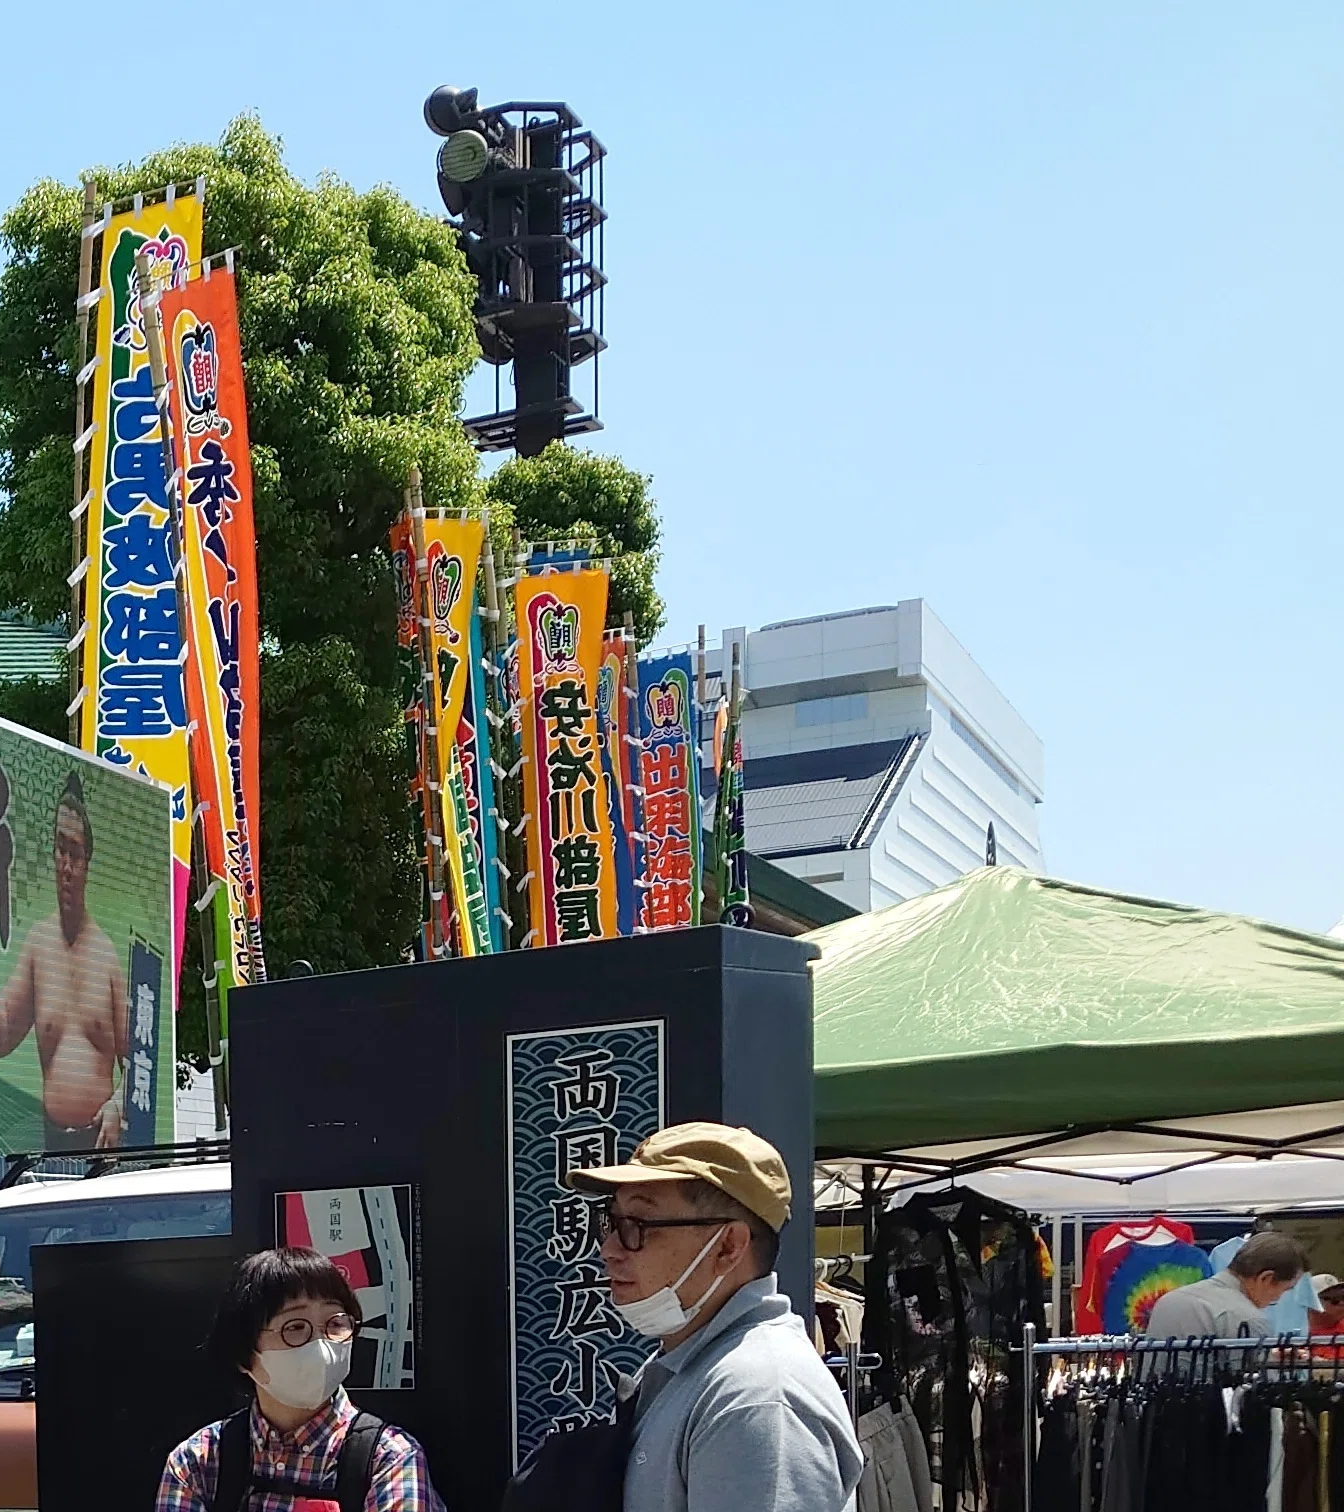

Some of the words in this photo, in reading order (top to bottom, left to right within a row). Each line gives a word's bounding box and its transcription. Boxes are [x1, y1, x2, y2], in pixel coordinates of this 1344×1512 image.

[130, 983, 156, 1112] 東京
[328, 1196, 343, 1243] 両国駅
[548, 1049, 625, 1437] 両国駅広小
